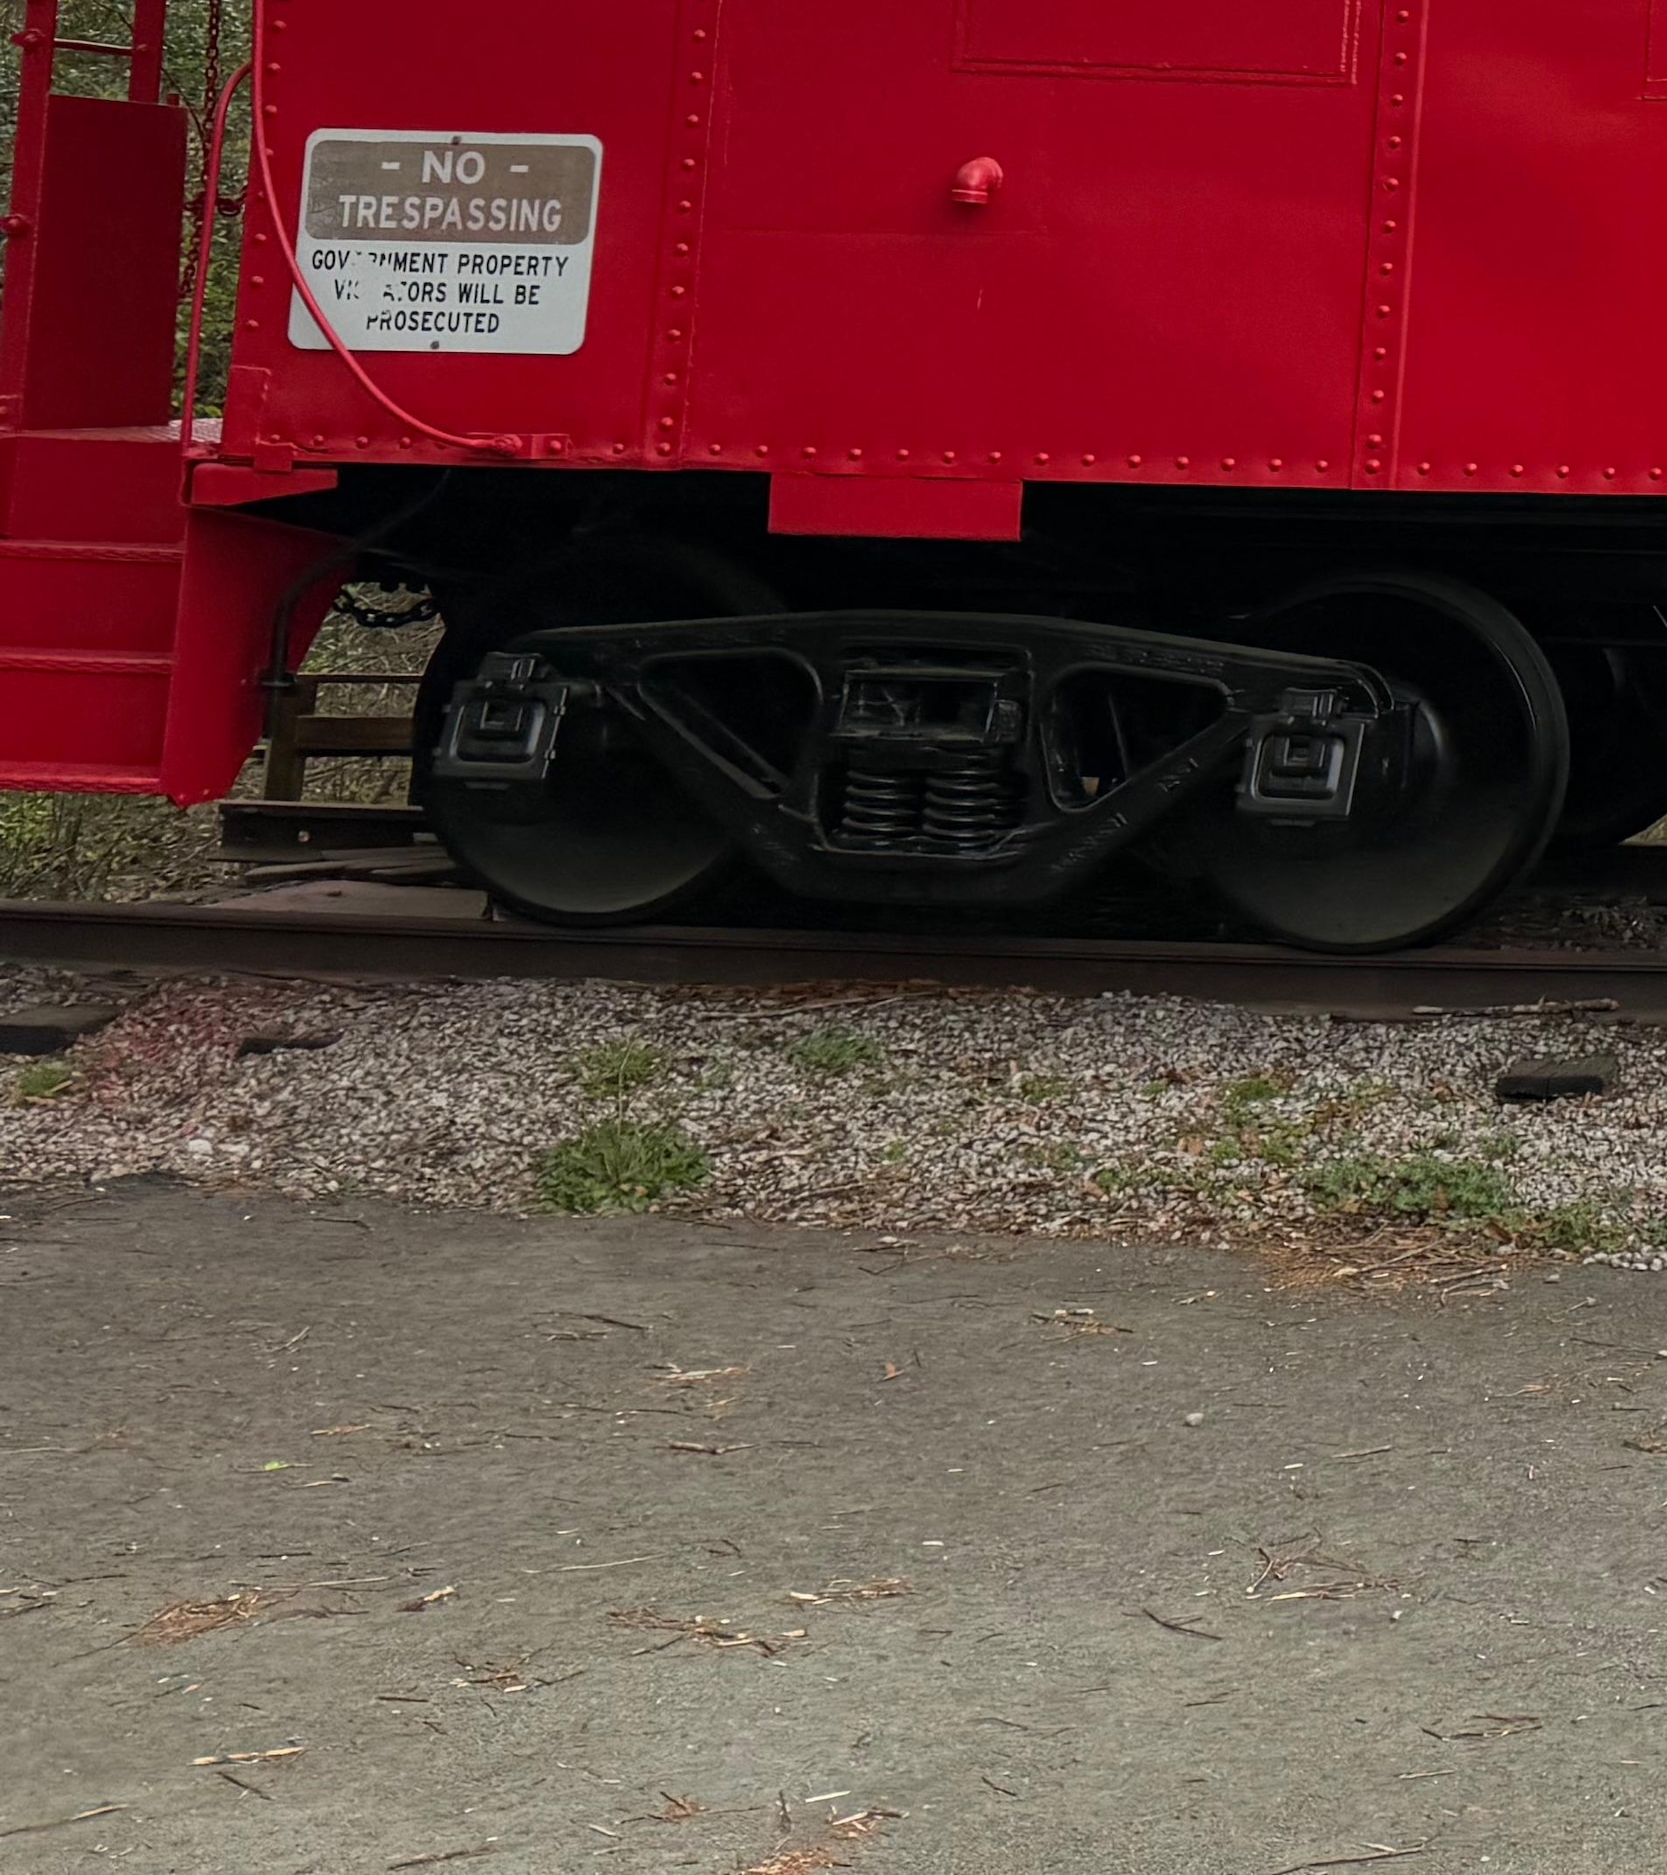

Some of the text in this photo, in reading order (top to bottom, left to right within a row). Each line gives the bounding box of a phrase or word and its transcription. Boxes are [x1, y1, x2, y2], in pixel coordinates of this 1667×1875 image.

[421, 150, 485, 185] NO
[338, 194, 563, 233] TRESPASSING
[457, 253, 569, 278] PROPERTY
[457, 282, 504, 305] WILL
[514, 284, 541, 305] BE
[366, 310, 500, 334] PROSECUTED
